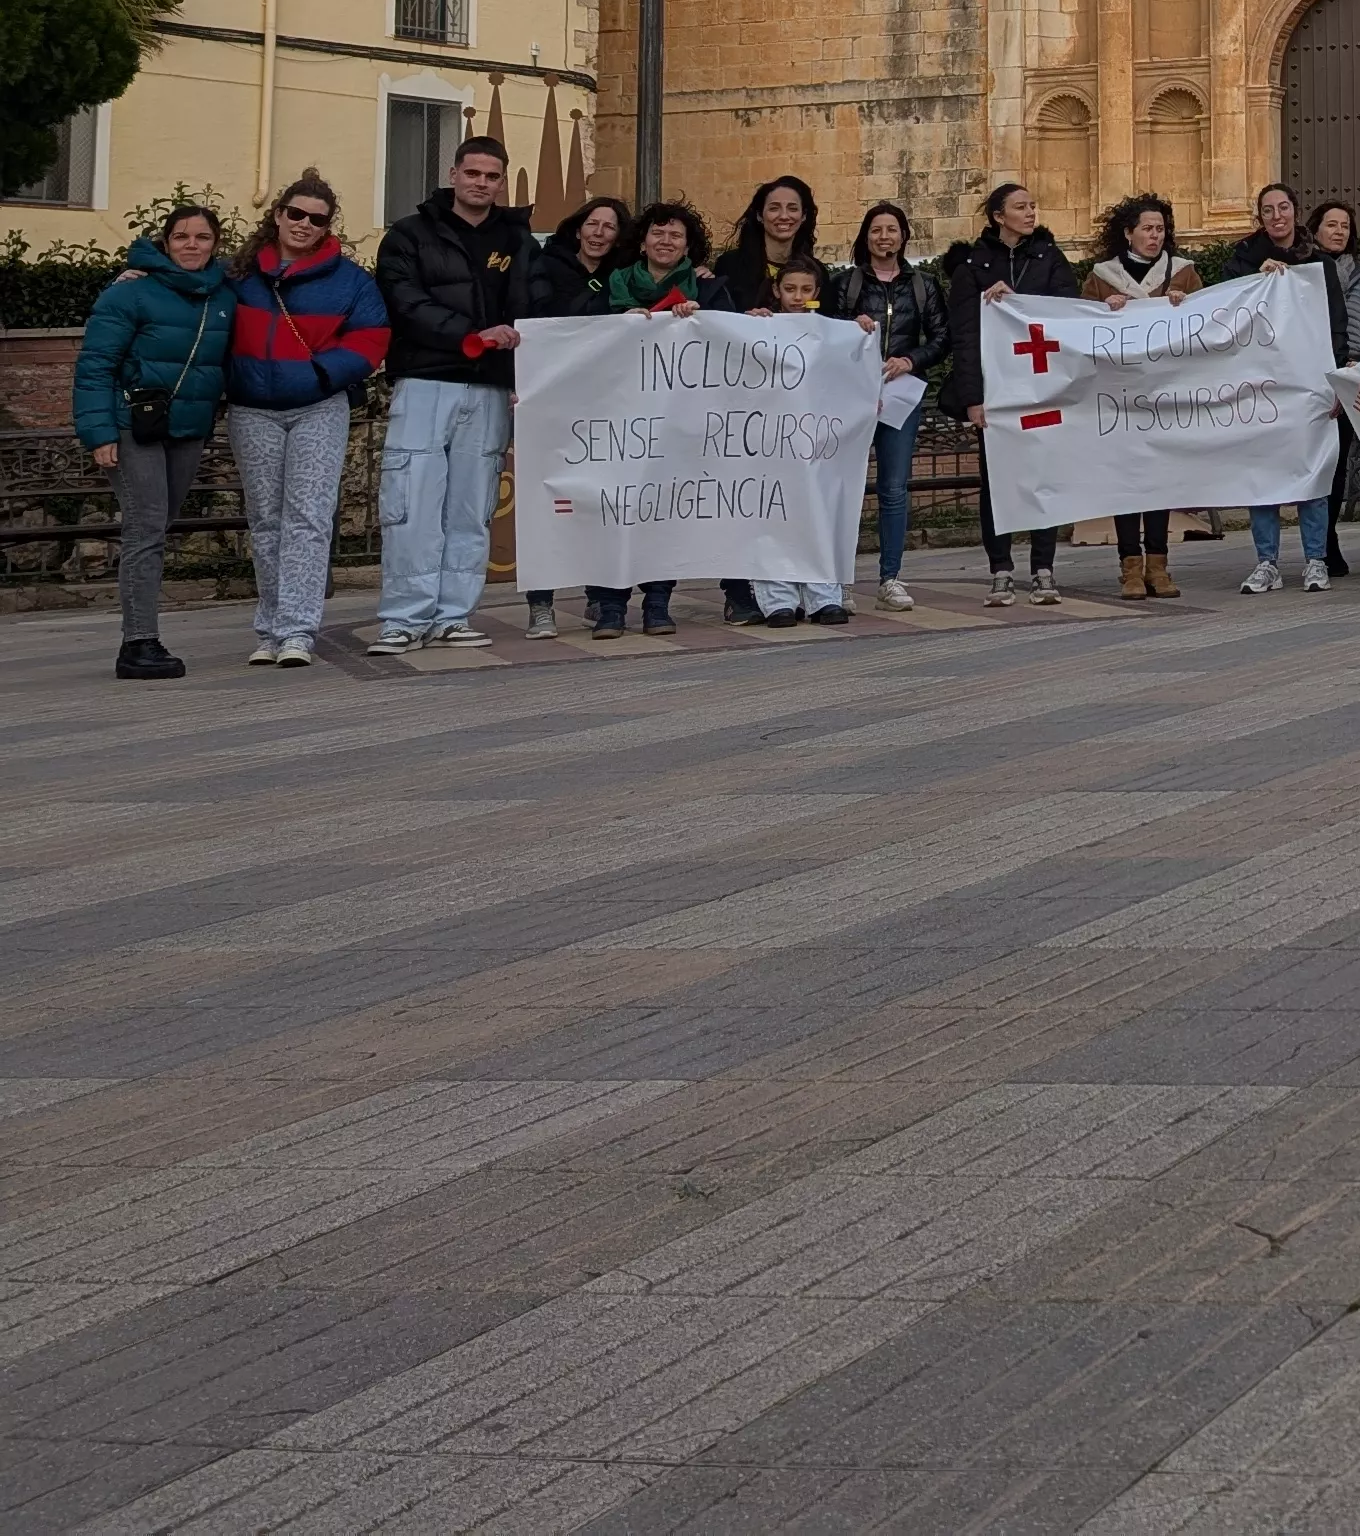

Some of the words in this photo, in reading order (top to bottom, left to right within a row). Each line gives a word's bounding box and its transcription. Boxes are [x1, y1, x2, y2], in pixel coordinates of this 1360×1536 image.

[1092, 300, 1276, 366] RECURSOS
[1097, 379, 1279, 437] DISCURSOS
[564, 416, 666, 465] SENSE
[702, 410, 843, 461] RECURSOS
[600, 470, 787, 527] NEGLIGÈNCIA
